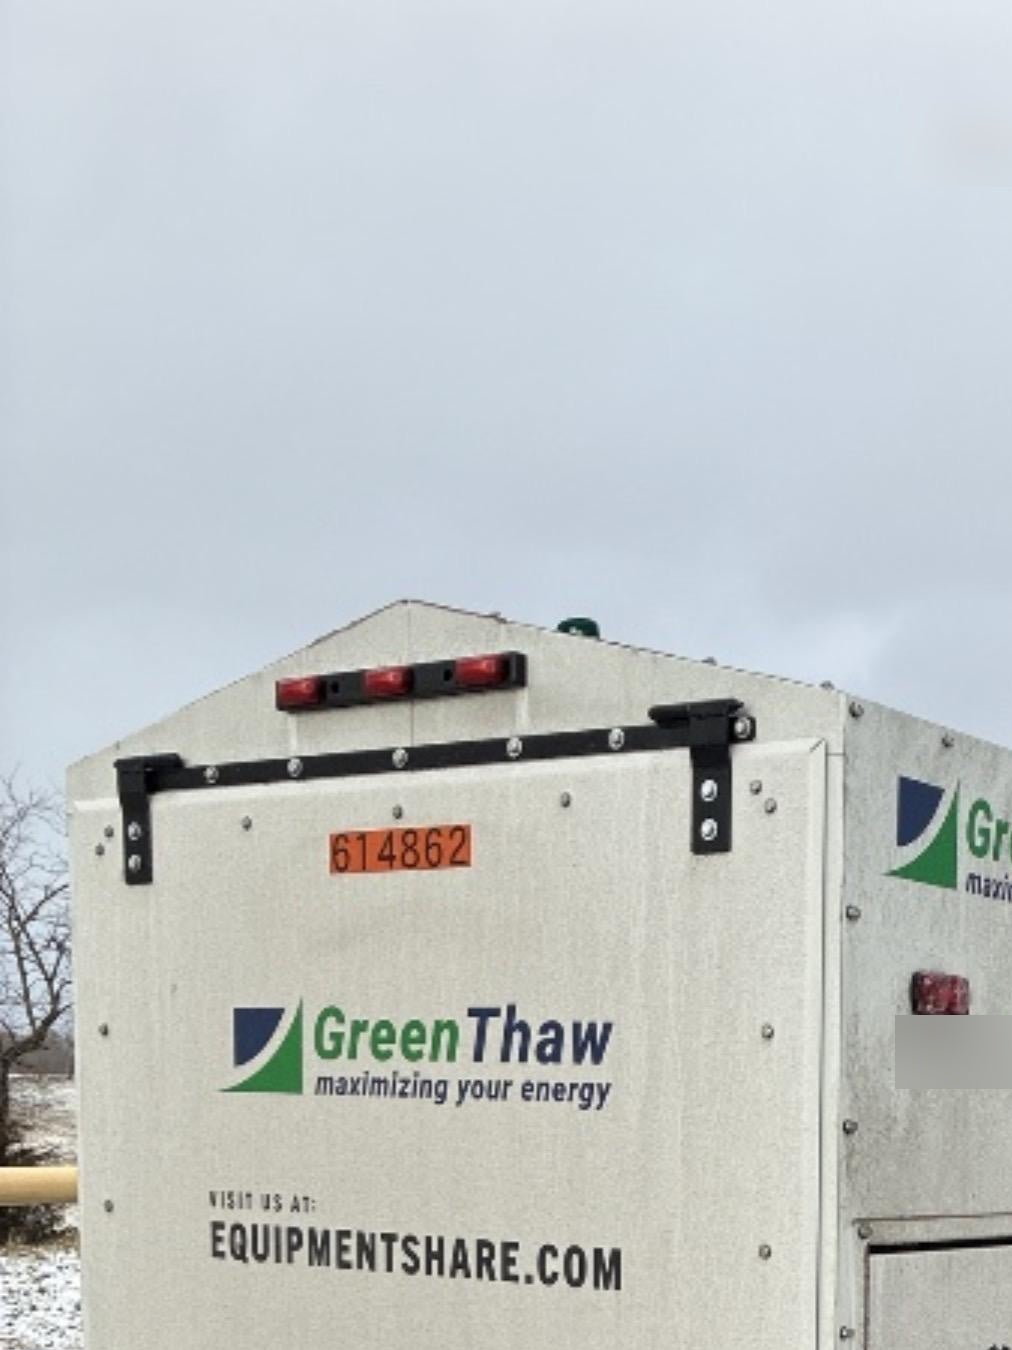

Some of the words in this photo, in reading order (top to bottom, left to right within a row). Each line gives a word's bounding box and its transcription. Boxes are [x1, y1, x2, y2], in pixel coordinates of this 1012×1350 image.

[332, 825, 466, 873] 614862
[313, 1003, 614, 1066] GreenThaw
[314, 1070, 448, 1105] maximizing
[455, 1078, 513, 1108] your
[521, 1080, 612, 1111] energy
[208, 1190, 253, 1210] VISIT
[261, 1193, 283, 1211] US
[290, 1195, 316, 1214] AT:
[209, 1219, 623, 1292] EQUIPMENTSHARE.COM
